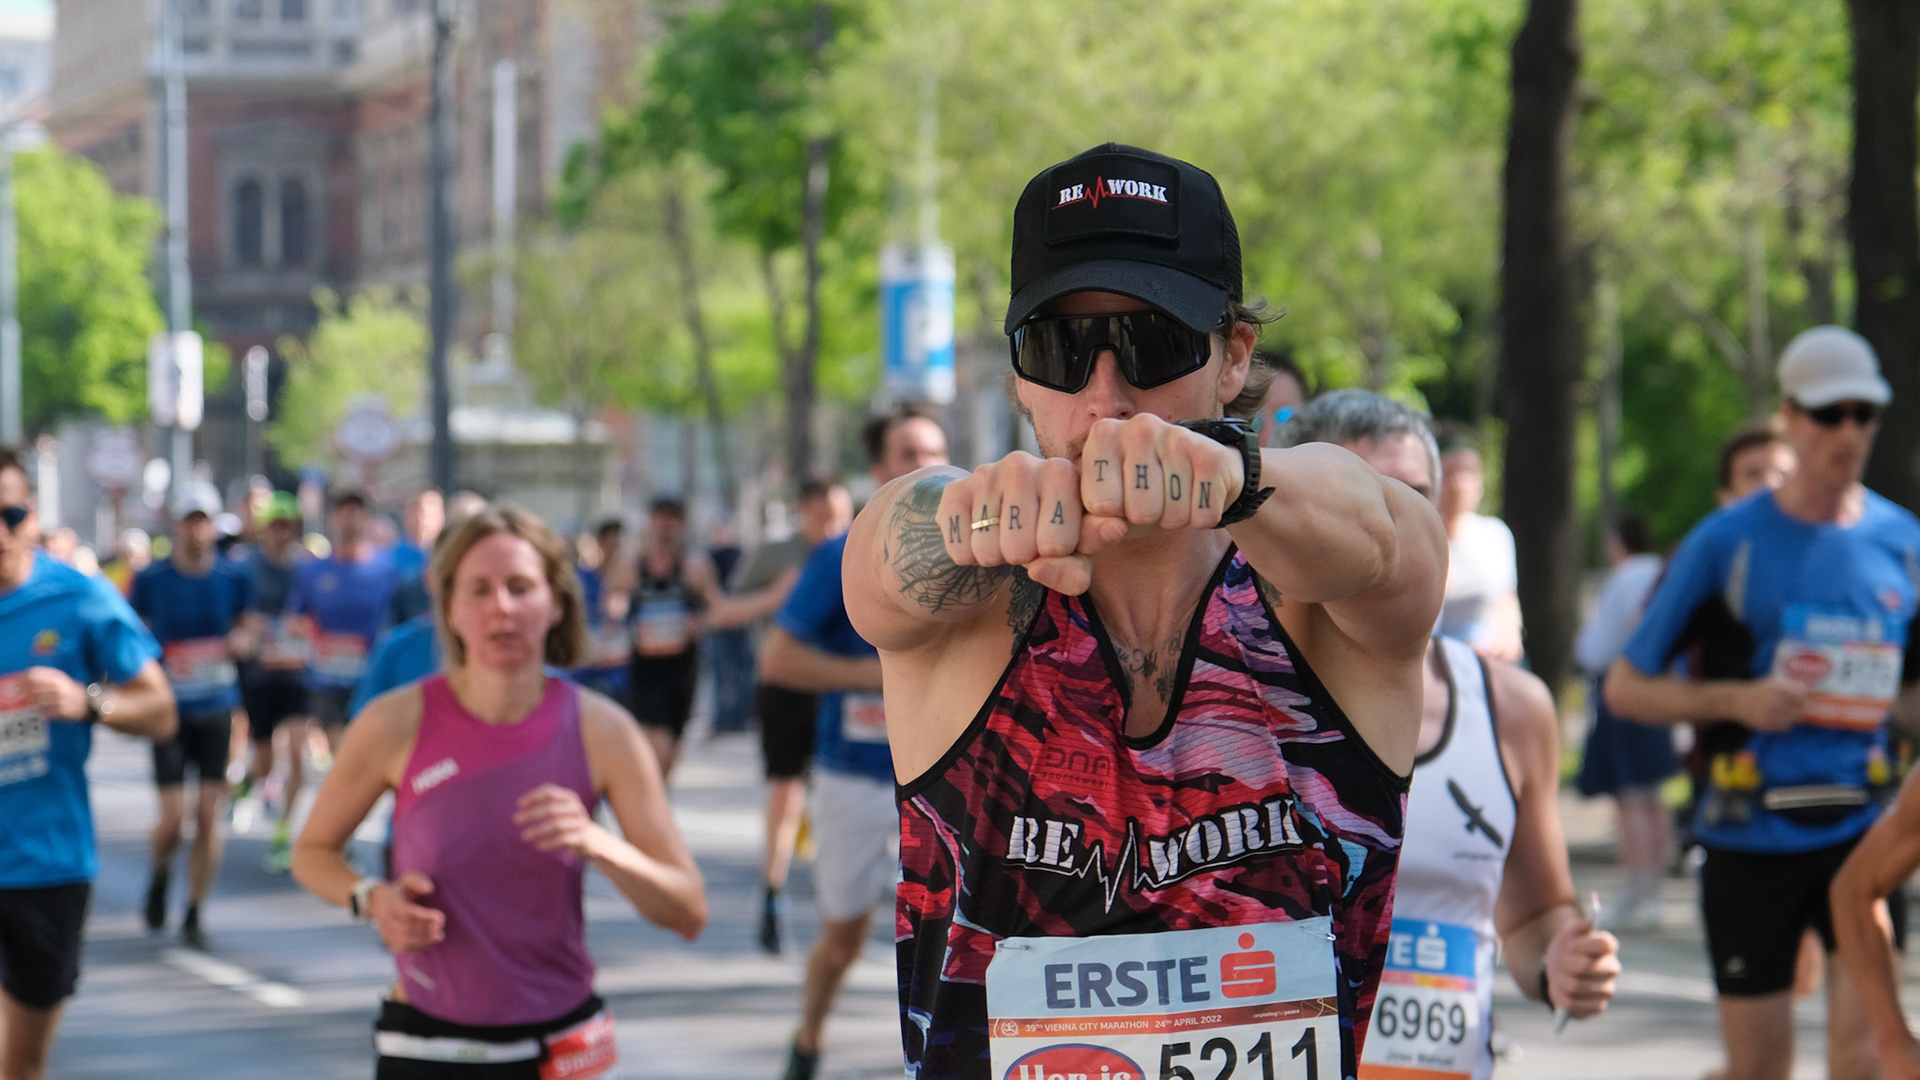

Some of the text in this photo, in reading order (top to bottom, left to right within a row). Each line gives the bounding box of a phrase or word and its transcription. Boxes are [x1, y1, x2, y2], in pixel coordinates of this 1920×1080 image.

[1059, 179, 1168, 205] RE WORK
[1094, 459, 1212, 509] THON
[1006, 799, 1304, 883] RE WORK
[1044, 956, 1211, 1010] ERSTE
[1045, 1022, 1077, 1032] VIENNA
[1080, 1022, 1098, 1031] CITY
[1100, 1020, 1149, 1030] MARATHON
[1174, 1017, 1199, 1027] APRIL
[1201, 1014, 1222, 1025] 2022
[1377, 995, 1467, 1045] 6969
